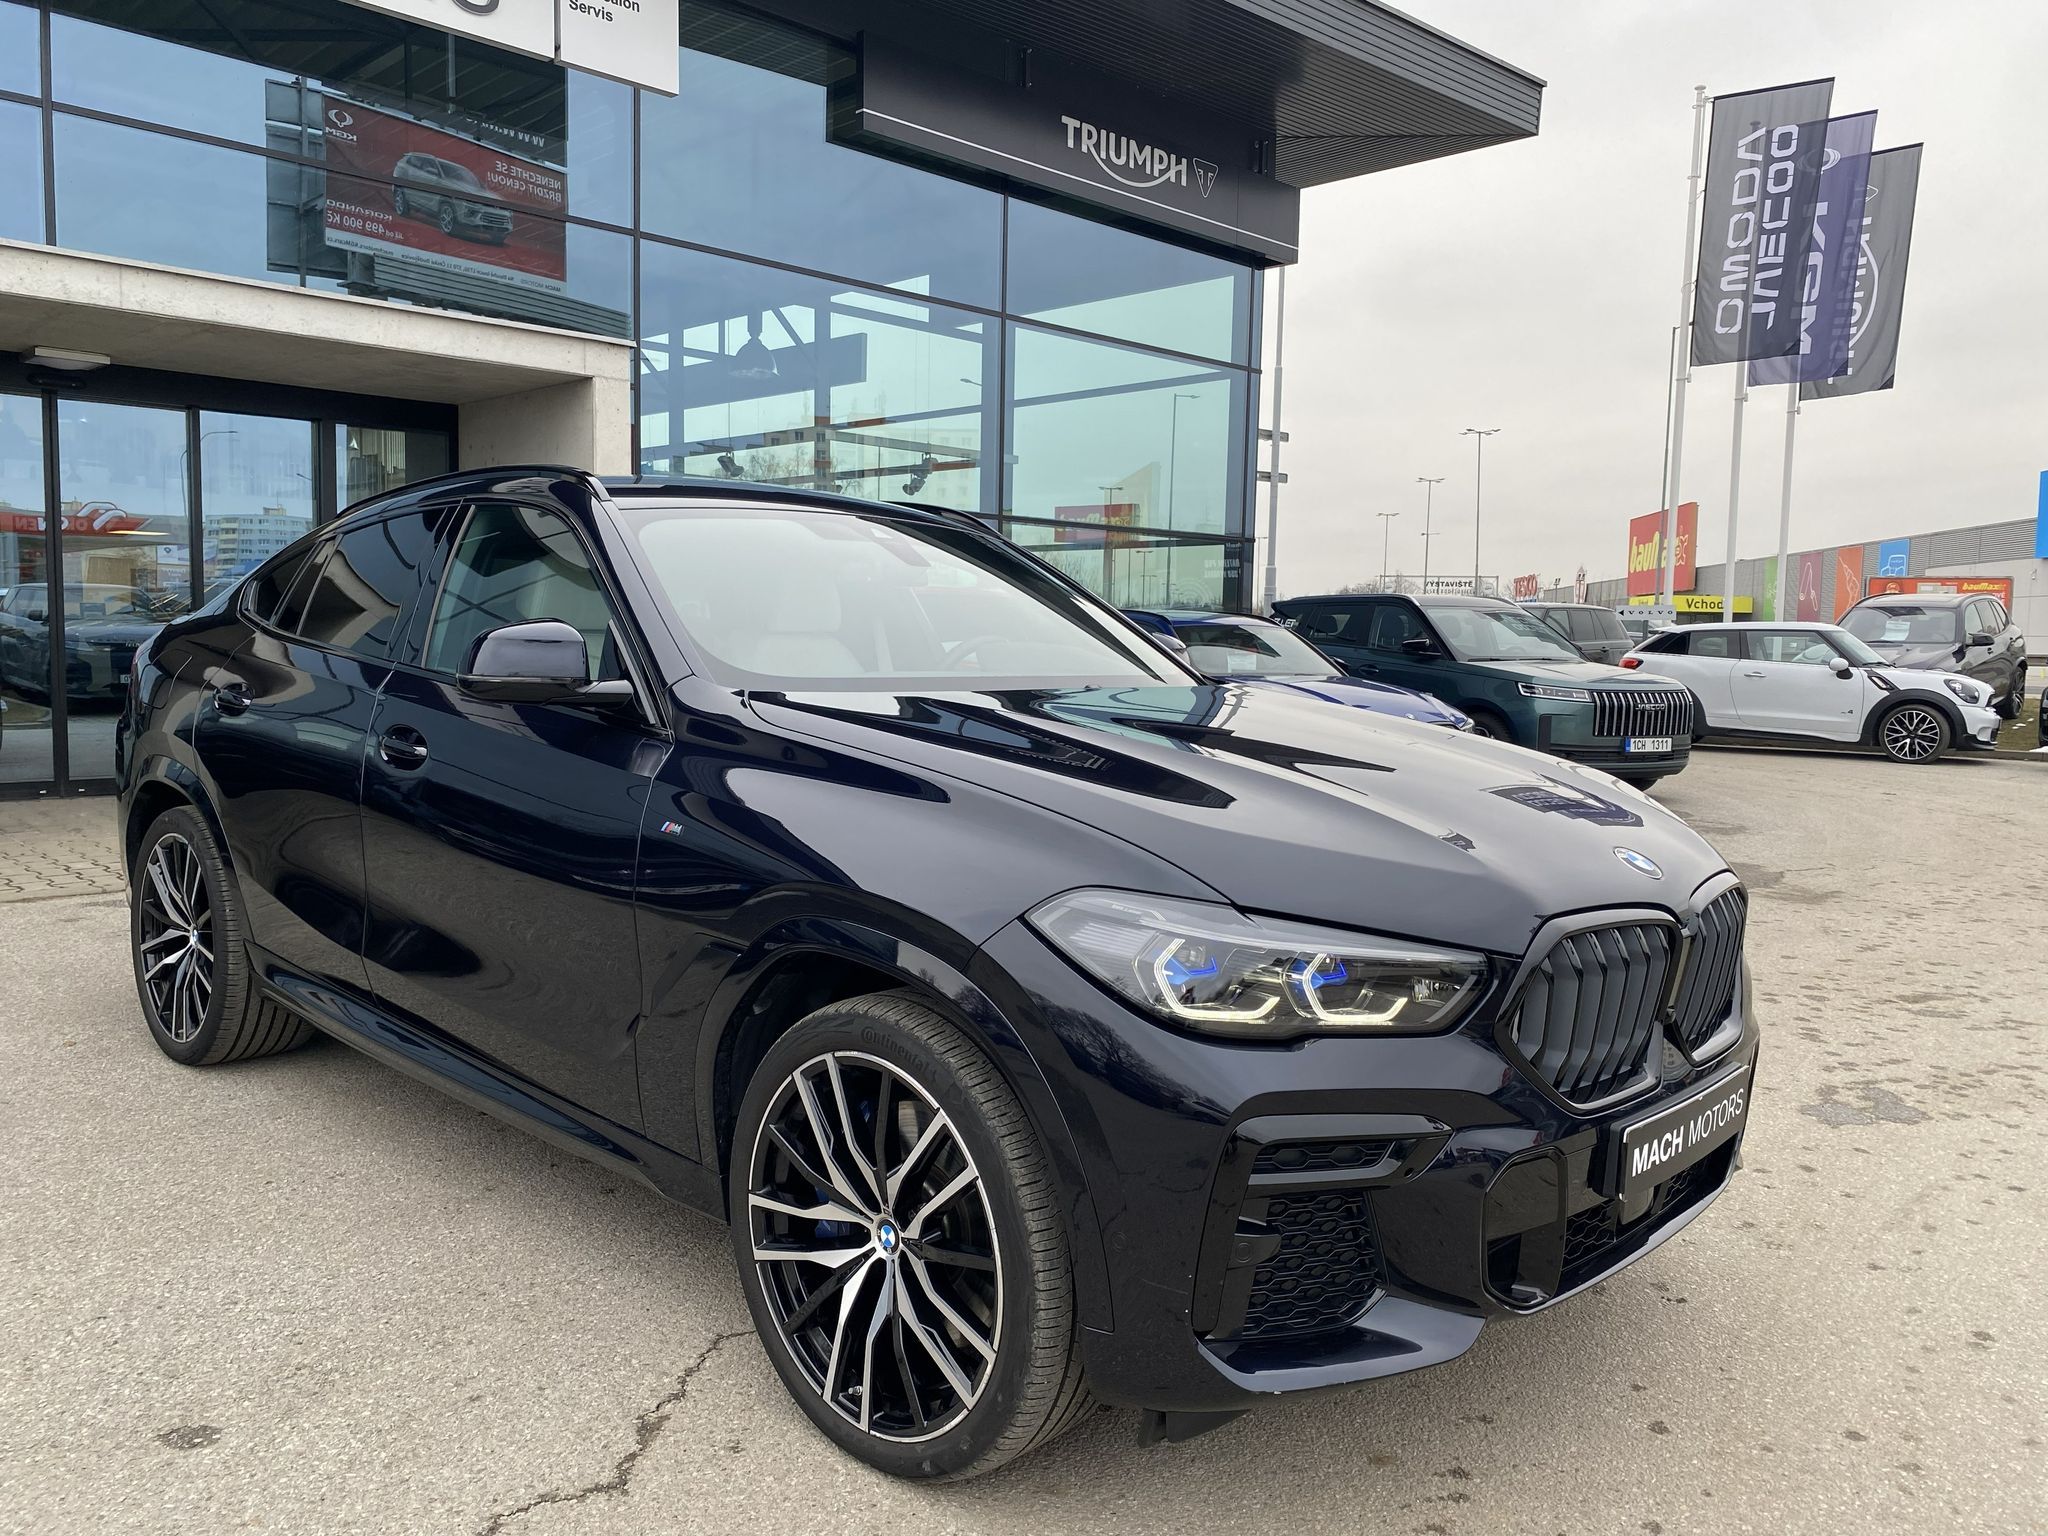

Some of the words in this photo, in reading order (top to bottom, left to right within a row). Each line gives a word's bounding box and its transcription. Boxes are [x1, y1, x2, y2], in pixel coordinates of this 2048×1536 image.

[569, 0, 613, 22] Servis
[1061, 115, 1188, 188] TRIUMPH
[1714, 127, 1767, 334] OMODA
[1751, 124, 1799, 330] JAECOO
[1632, 740, 1646, 750] 1CH
[1651, 739, 1669, 749] 1311
[1631, 1125, 1684, 1177] MACH
[1688, 1088, 1744, 1147] MOTORS
